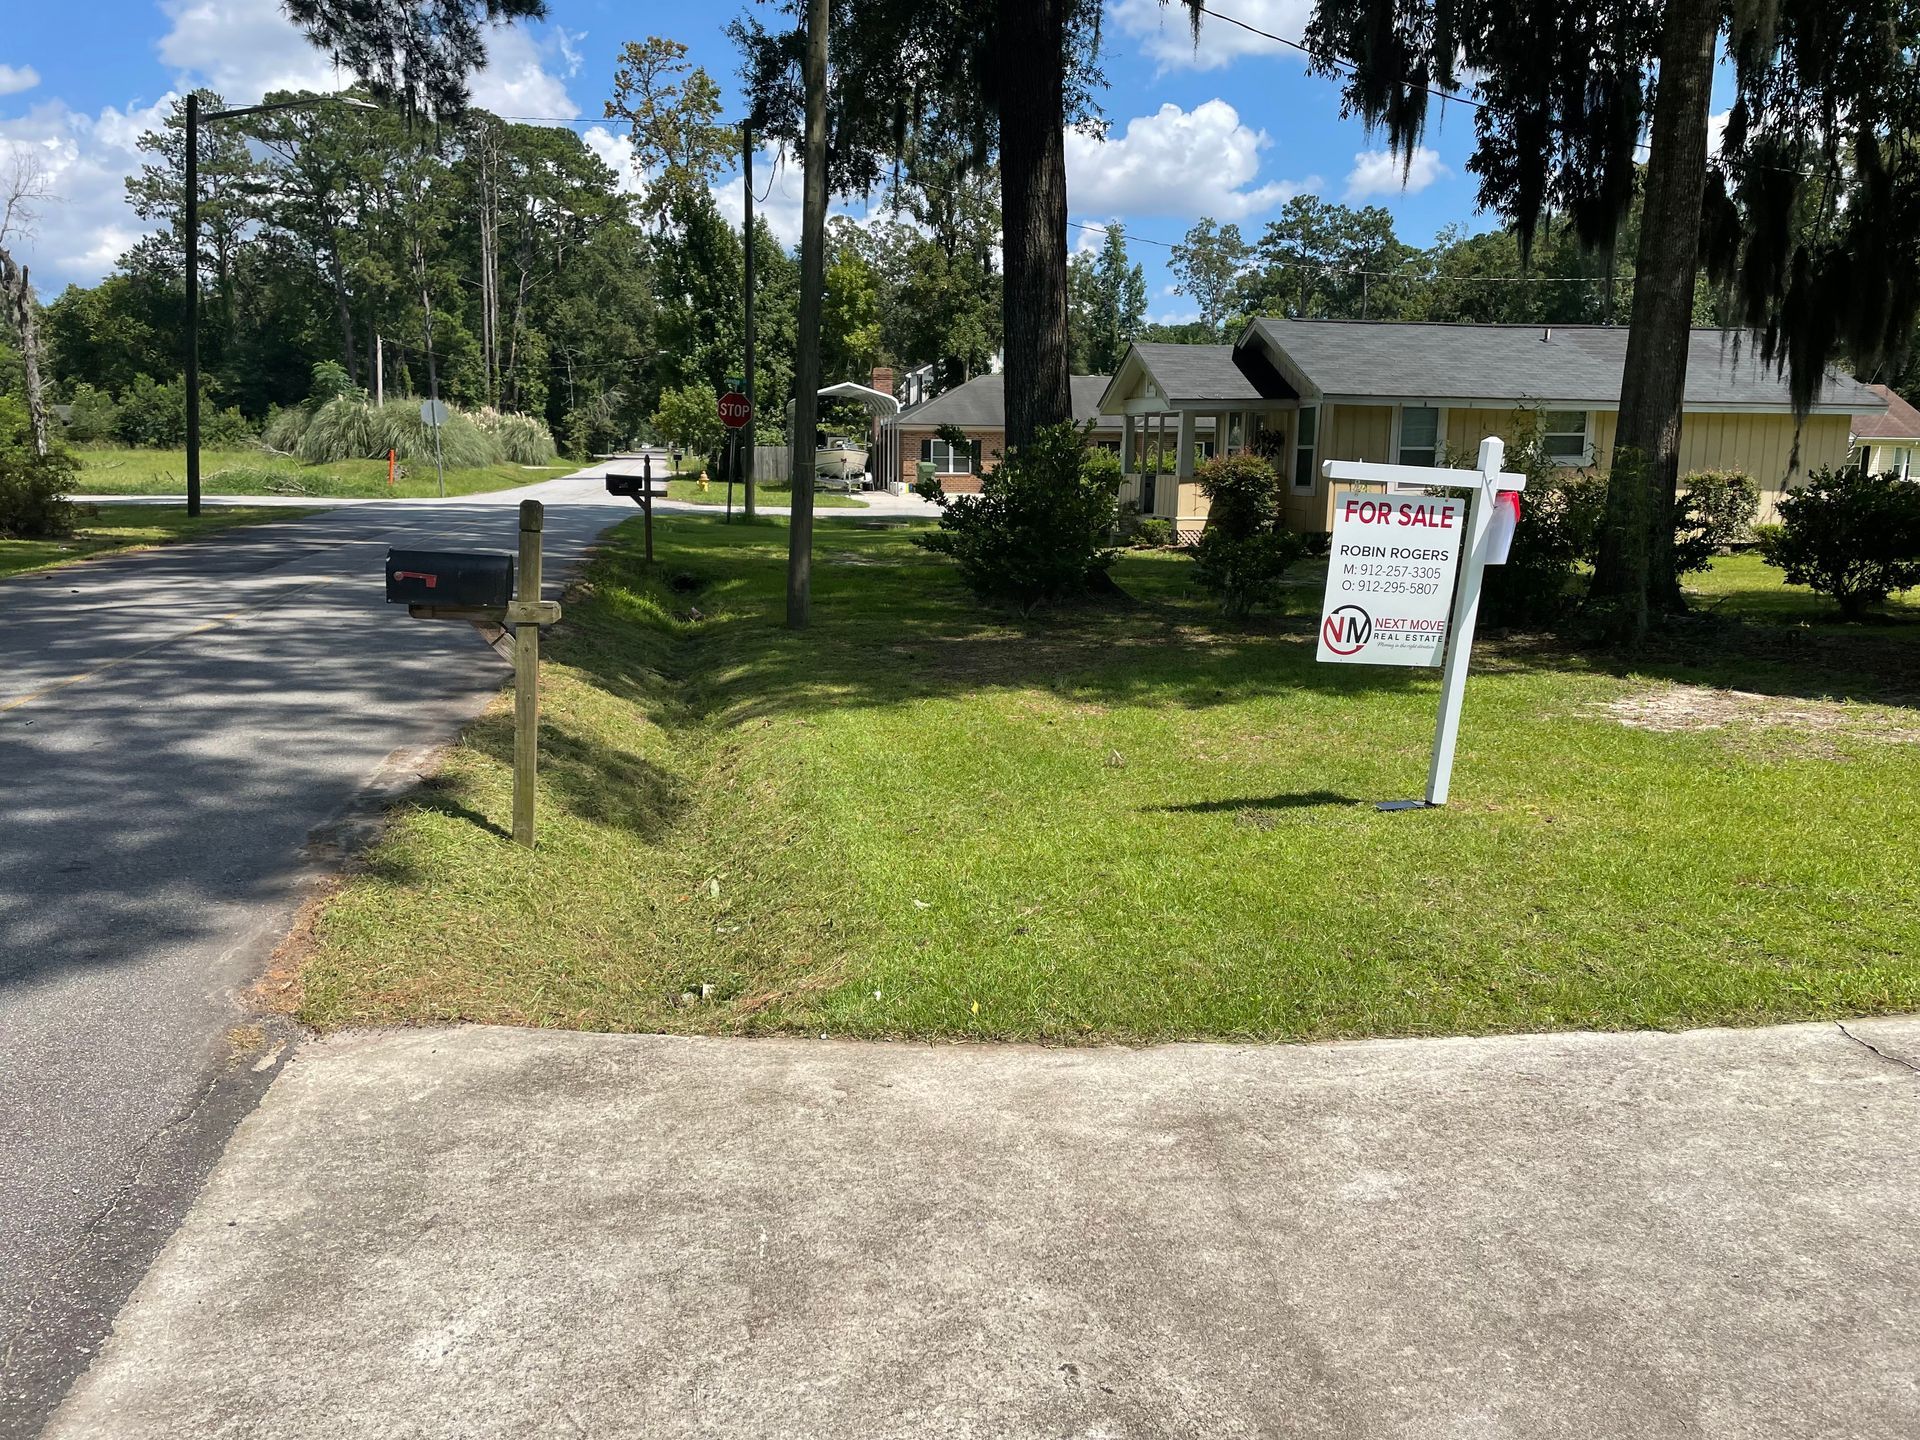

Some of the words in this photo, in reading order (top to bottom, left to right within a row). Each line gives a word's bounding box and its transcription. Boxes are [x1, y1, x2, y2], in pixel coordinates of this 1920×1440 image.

[720, 402, 750, 417] STOP
[1345, 500, 1392, 524] FOR
[1397, 503, 1455, 528] SALE
[1340, 545, 1386, 558] ROBIN
[1390, 547, 1449, 561] ROGERS
[1343, 563, 1357, 575] M:
[1360, 564, 1441, 580] 912-257-3305
[1342, 579, 1355, 591] O:
[1358, 580, 1439, 595] 912-295-5807
[1375, 618, 1407, 629] NEXT
[1409, 619, 1445, 631] MOVE
[1373, 632, 1399, 641] REAL
[1405, 634, 1443, 643] ESTATE
